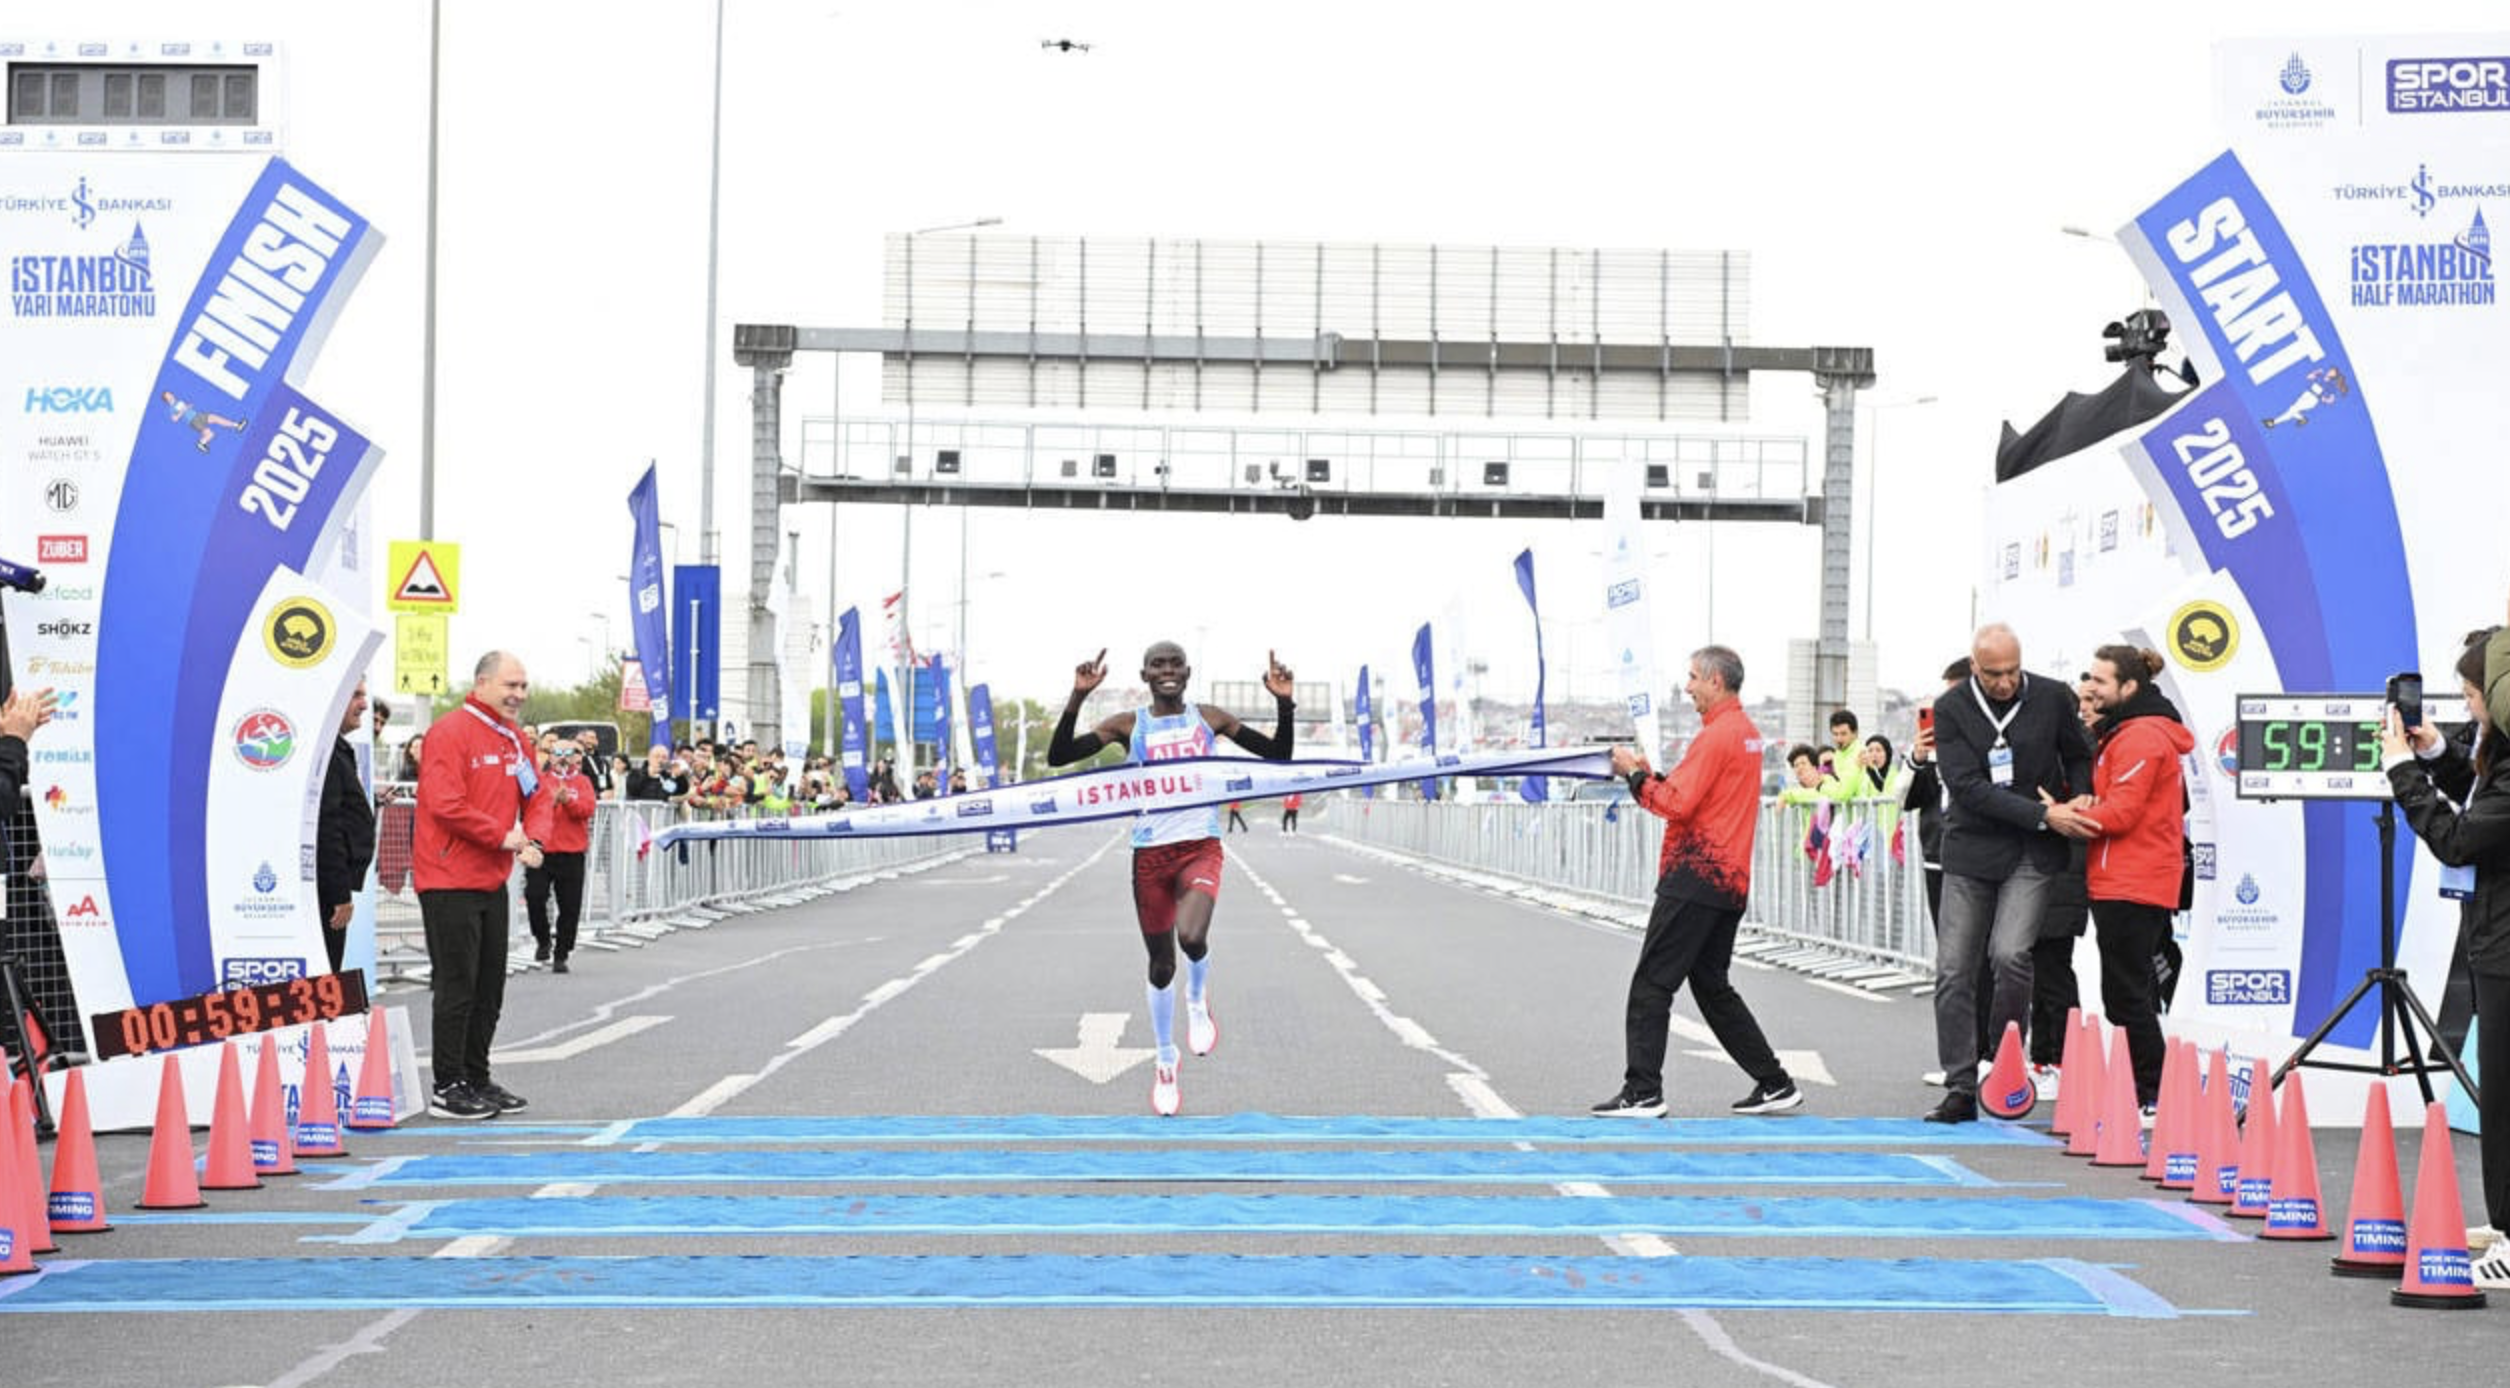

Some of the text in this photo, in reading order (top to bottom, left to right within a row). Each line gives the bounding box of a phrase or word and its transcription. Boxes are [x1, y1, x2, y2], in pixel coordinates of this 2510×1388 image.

[2394, 62, 2508, 90] SPOR
[173, 183, 353, 400] FINISH
[2166, 195, 2326, 386] START
[2352, 283, 2495, 306] HALF MARATHON
[12, 295, 156, 317] YARI MARATONU
[25, 387, 114, 412] HOKA
[39, 435, 89, 446] HUAWEI
[239, 407, 338, 531] 2025
[2172, 417, 2274, 539] 2025
[48, 482, 76, 509] MG
[227, 962, 300, 978] SPOR
[2211, 973, 2285, 990] SPOR
[121, 975, 344, 1053] 00:59:39
